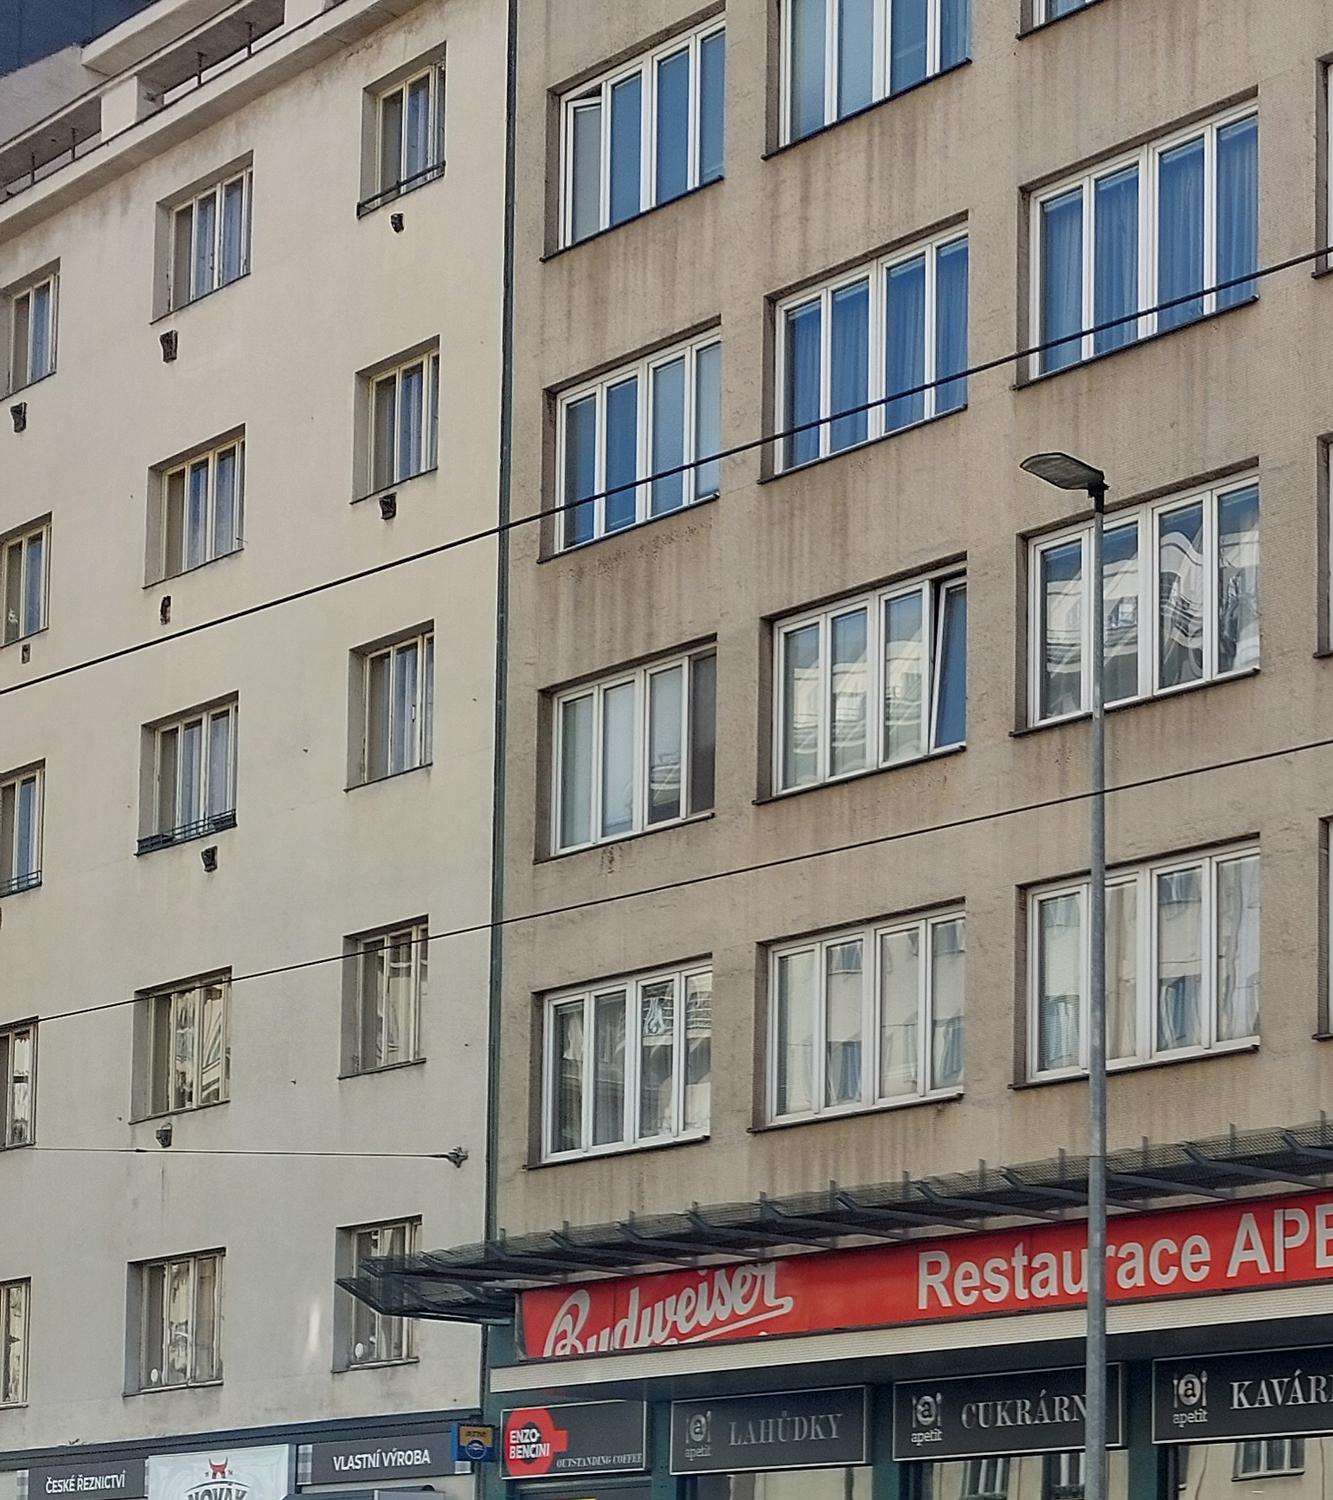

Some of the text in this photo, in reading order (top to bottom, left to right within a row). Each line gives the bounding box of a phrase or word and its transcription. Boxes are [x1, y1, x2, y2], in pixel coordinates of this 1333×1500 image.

[543, 1261, 795, 1358] Budweiser
[961, 1387, 1087, 1430] CUKRÁRN
[1172, 1408, 1209, 1428] apetit
[728, 1409, 844, 1447] LAHŮDKY
[910, 1427, 943, 1447] apetit
[333, 1447, 431, 1472] VLASTNÍ VÝROBA
[509, 1443, 550, 1460] BENCINI
[556, 1452, 643, 1468] OUTSTANDING COFFEE
[684, 1444, 712, 1462] apetit
[45, 1469, 127, 1495] ČESKÉ ŘEZNICTVÍ
